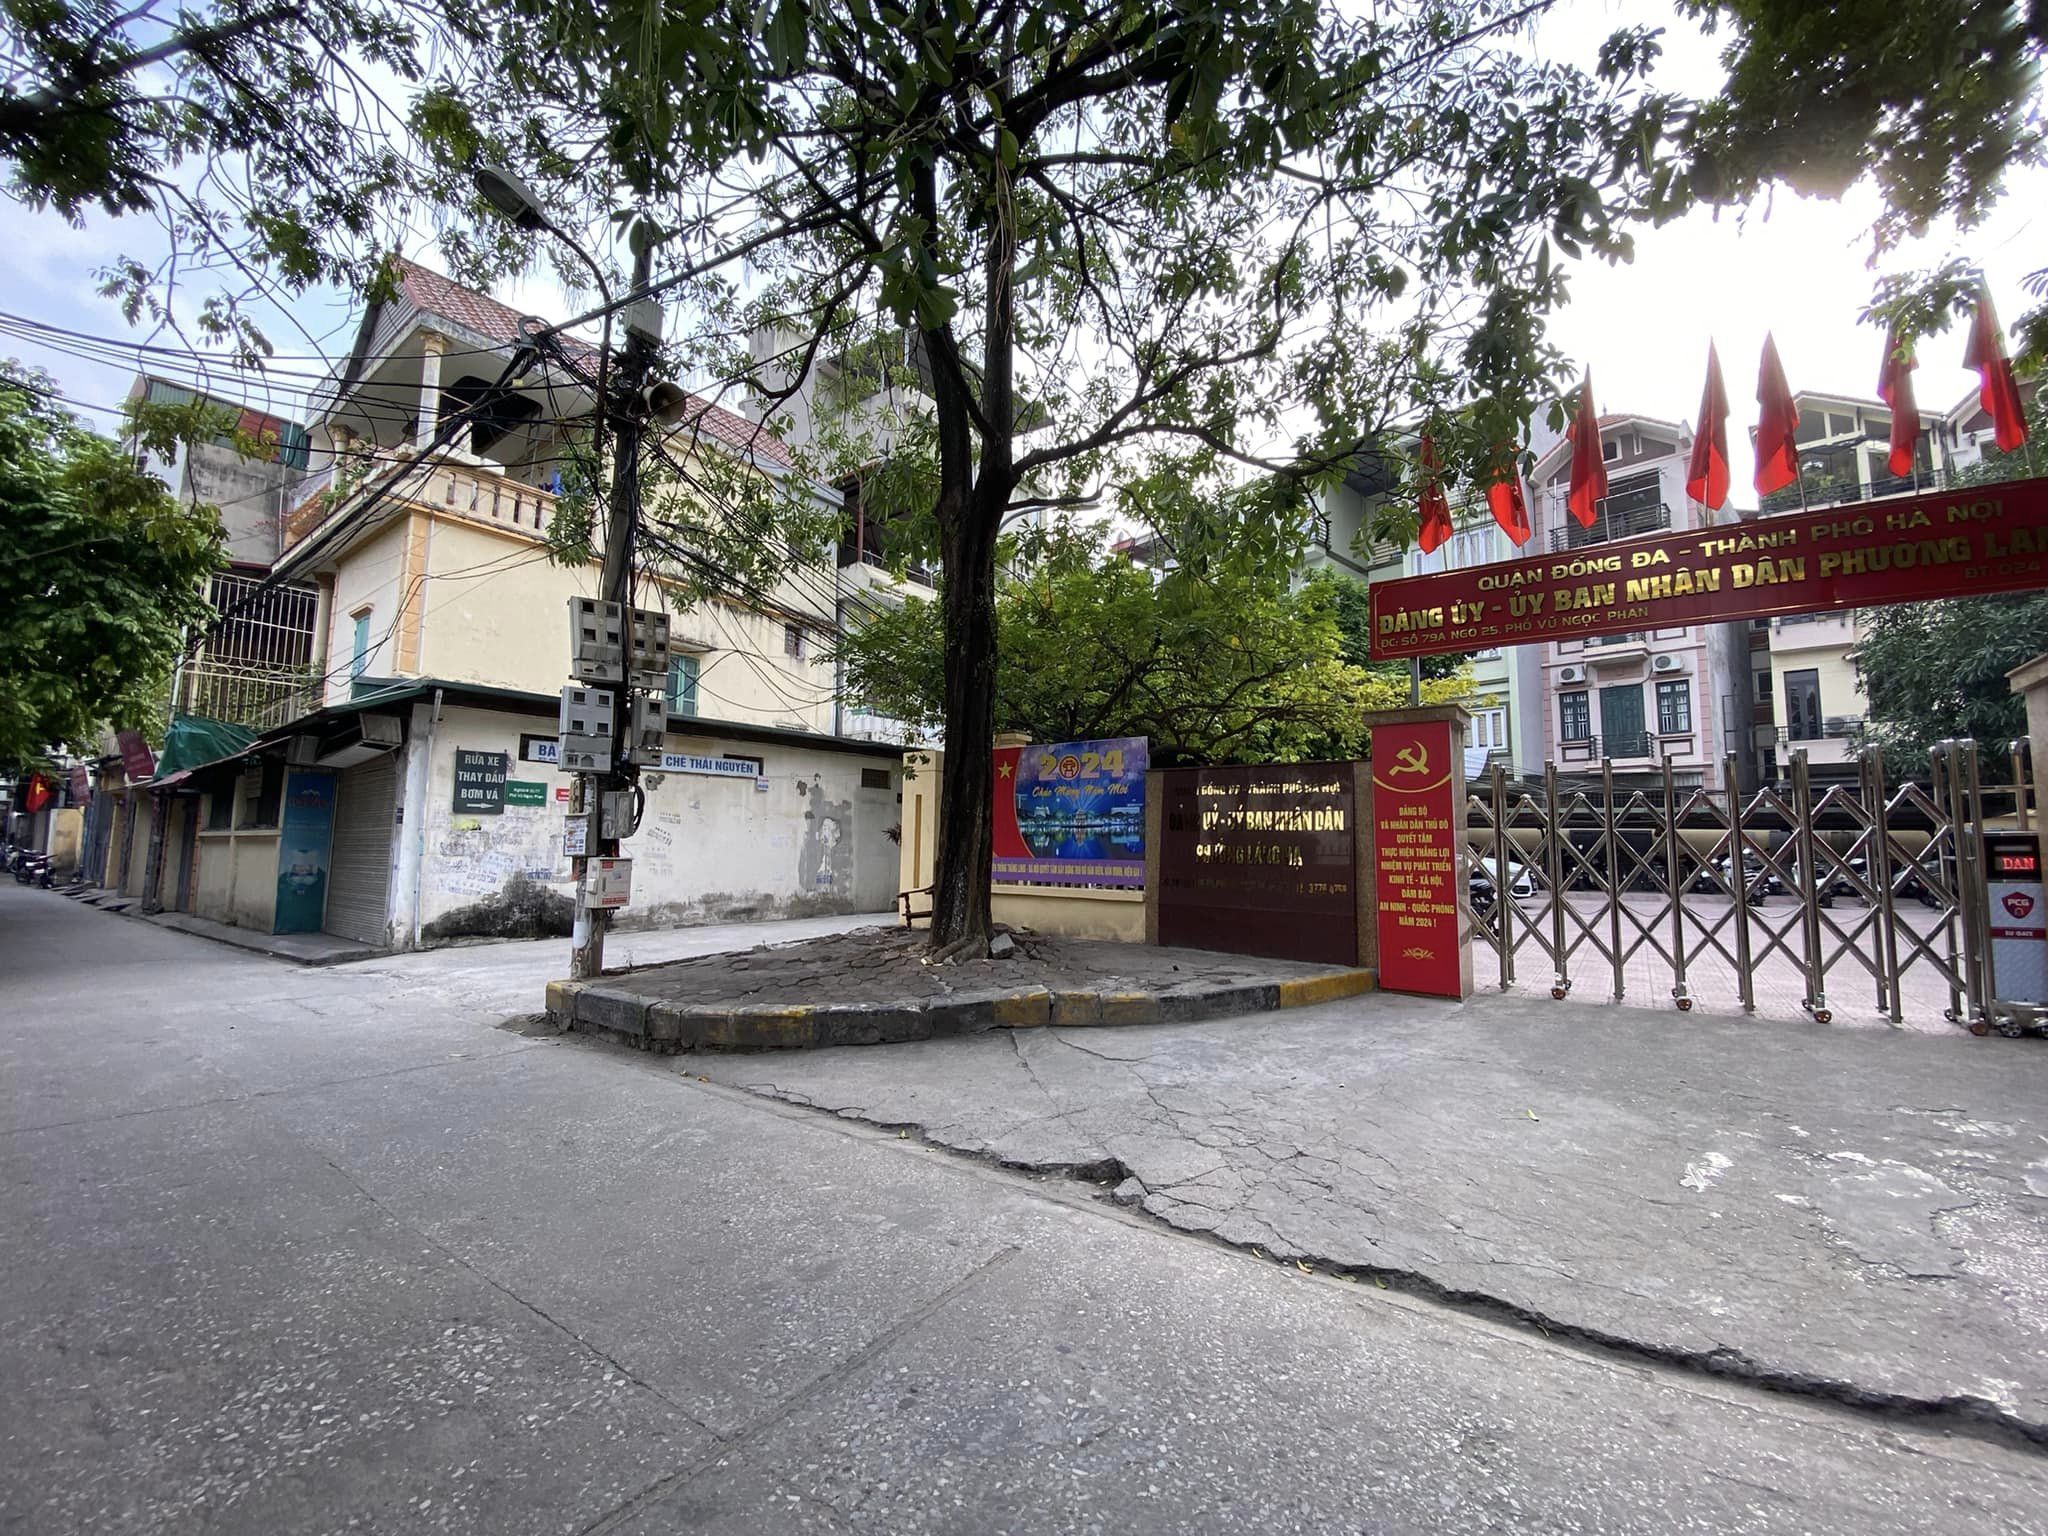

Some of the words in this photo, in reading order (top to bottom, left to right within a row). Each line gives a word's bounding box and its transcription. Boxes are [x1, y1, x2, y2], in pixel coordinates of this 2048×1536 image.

[1478, 568, 1543, 590] QUẬN
[1551, 554, 1622, 579] ĐỐNG
[1631, 549, 1671, 568] ĐA
[1699, 529, 1797, 557] THÀNH
[1886, 506, 1932, 530] HÀ
[1379, 607, 1444, 634] ĐẢNG
[1554, 583, 1615, 611] BAN
[1626, 567, 1720, 602] NHÂN
[1731, 556, 1806, 589] DÂN
[1423, 633, 1447, 643] 79A
[1563, 613, 1600, 628] NGỌC
[1607, 607, 1649, 621] PHAN
[487, 756, 500, 767] XE
[458, 770, 483, 782] THAY
[461, 787, 484, 799] BƠM
[486, 788, 498, 800] VÁ
[1315, 805, 1345, 831] DÂN
[2003, 857, 2034, 870] DAN
